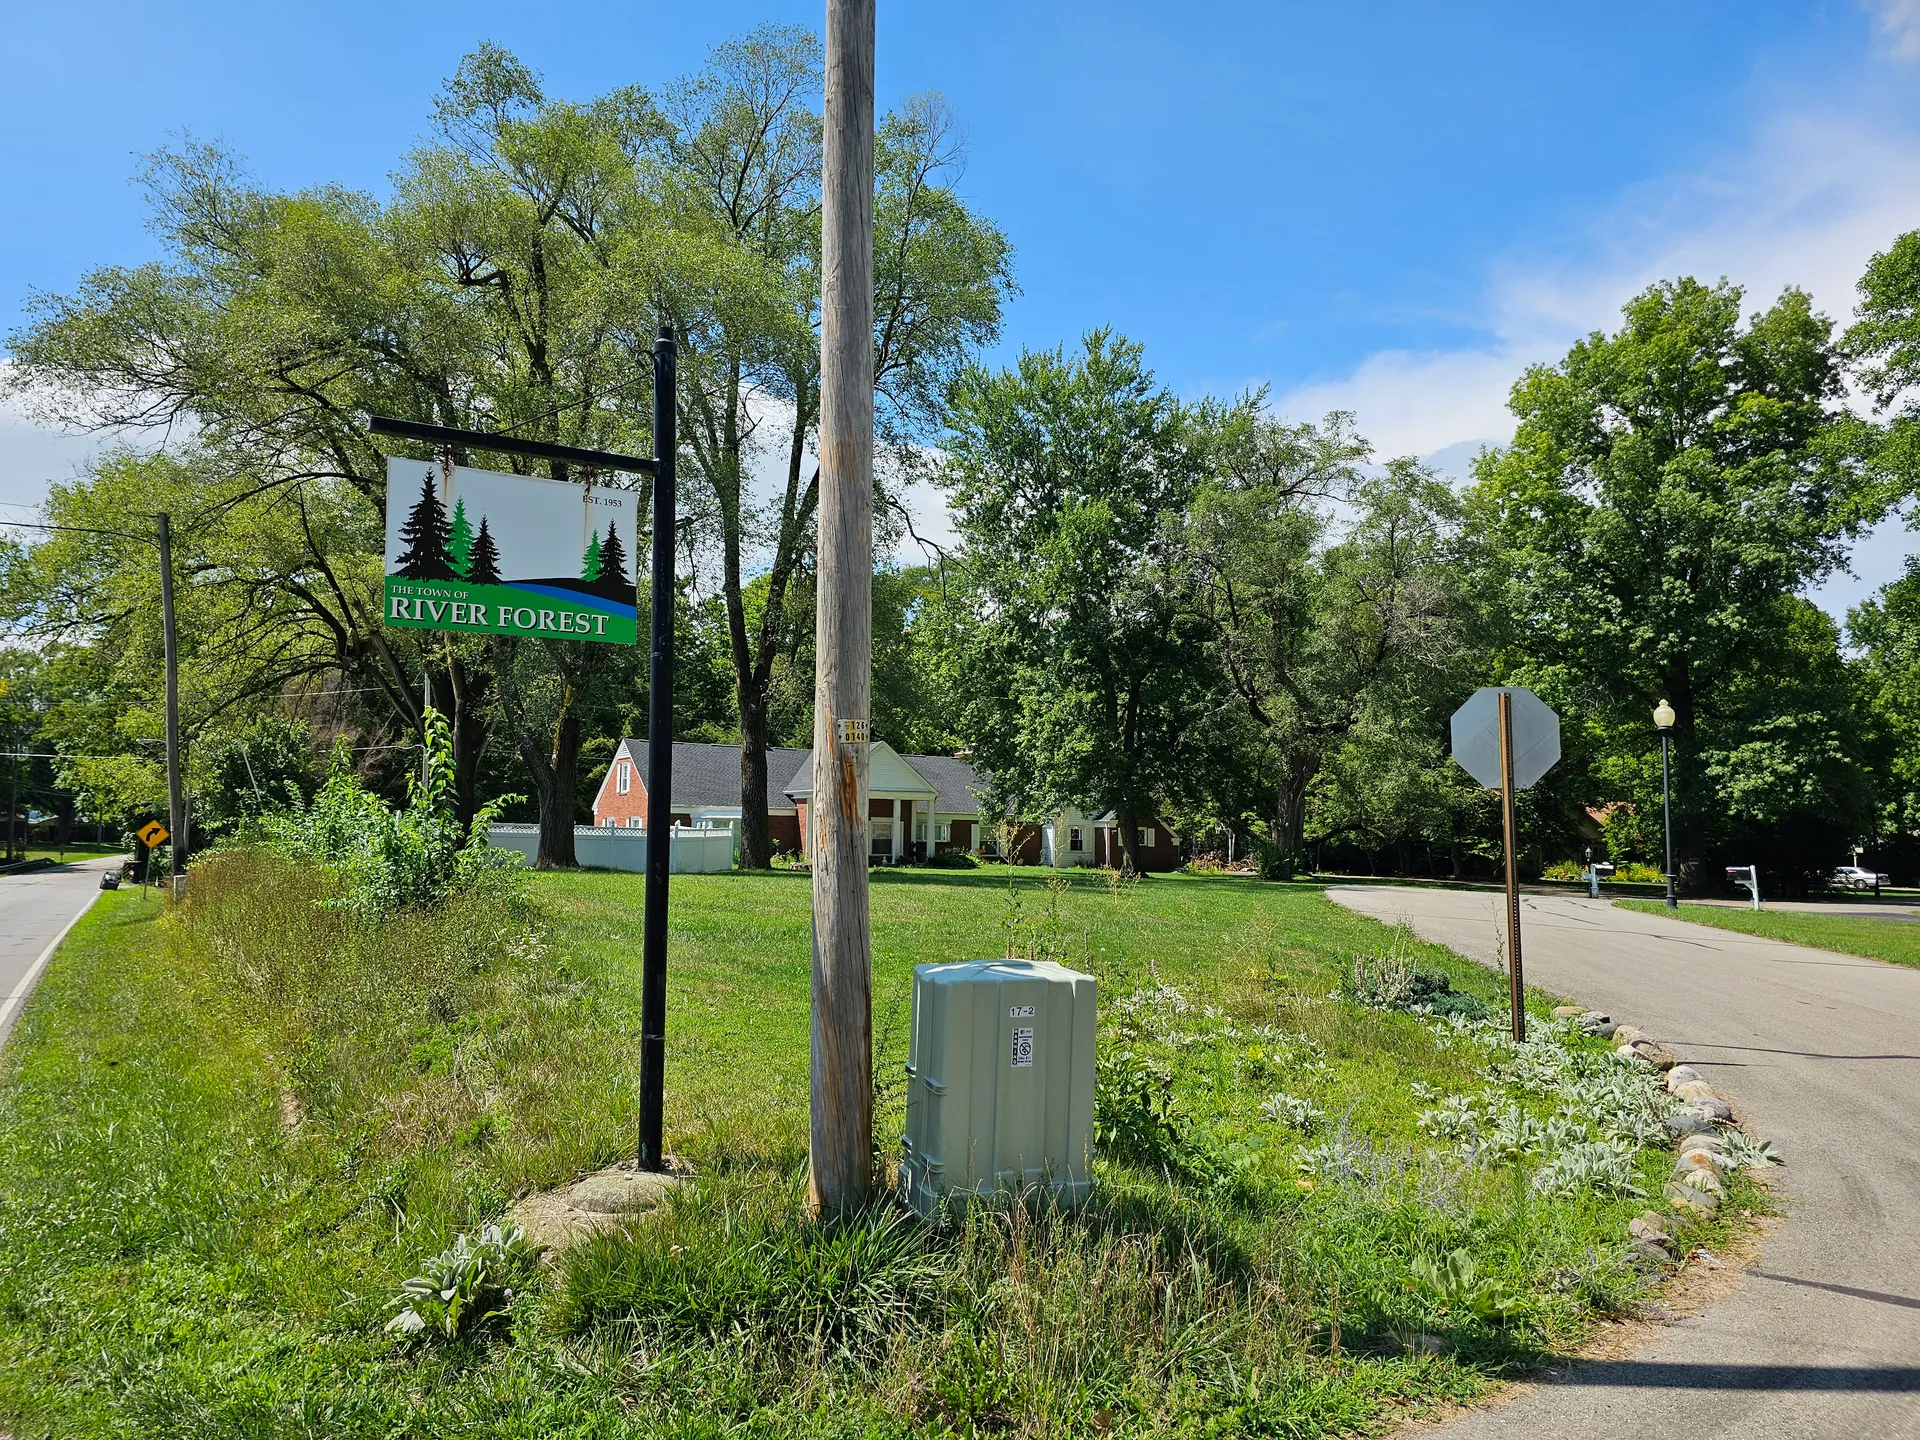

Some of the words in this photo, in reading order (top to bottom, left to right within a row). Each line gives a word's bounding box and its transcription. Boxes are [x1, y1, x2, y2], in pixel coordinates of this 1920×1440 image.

[582, 495, 602, 505] EST.
[604, 498, 622, 508] 1953
[391, 585, 413, 595] THE
[416, 587, 451, 598] TOWN
[454, 590, 469, 599] OF
[390, 597, 489, 626] RIVER
[497, 606, 610, 636] FOREST
[845, 732, 865, 741] 0140
[1011, 1007, 1034, 1016] 17-2
